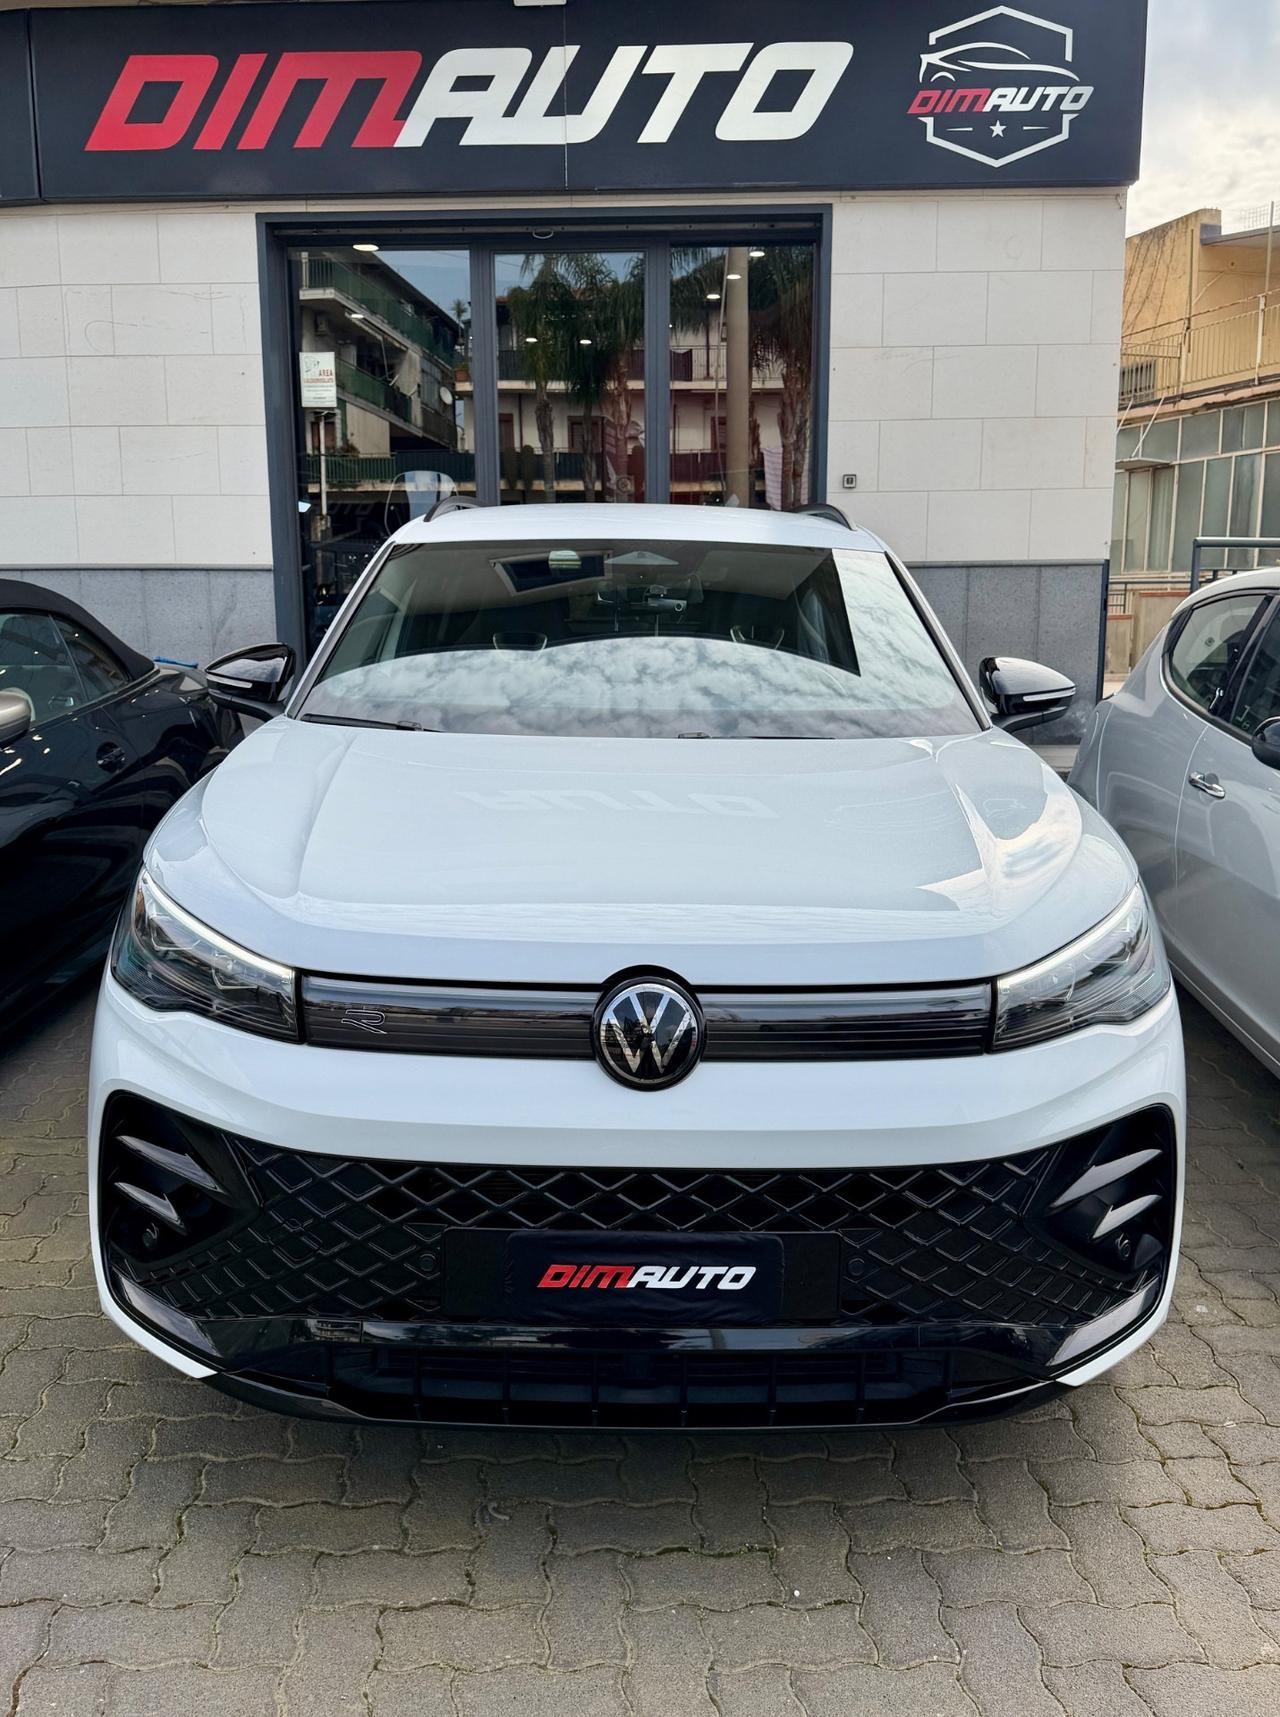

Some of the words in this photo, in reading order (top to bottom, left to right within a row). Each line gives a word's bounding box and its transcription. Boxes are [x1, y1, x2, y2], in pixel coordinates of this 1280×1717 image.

[85, 42, 854, 152] DIMAUTO
[907, 86, 1095, 115] DIMAUTO
[537, 1264, 757, 1290] DIMAUTO
